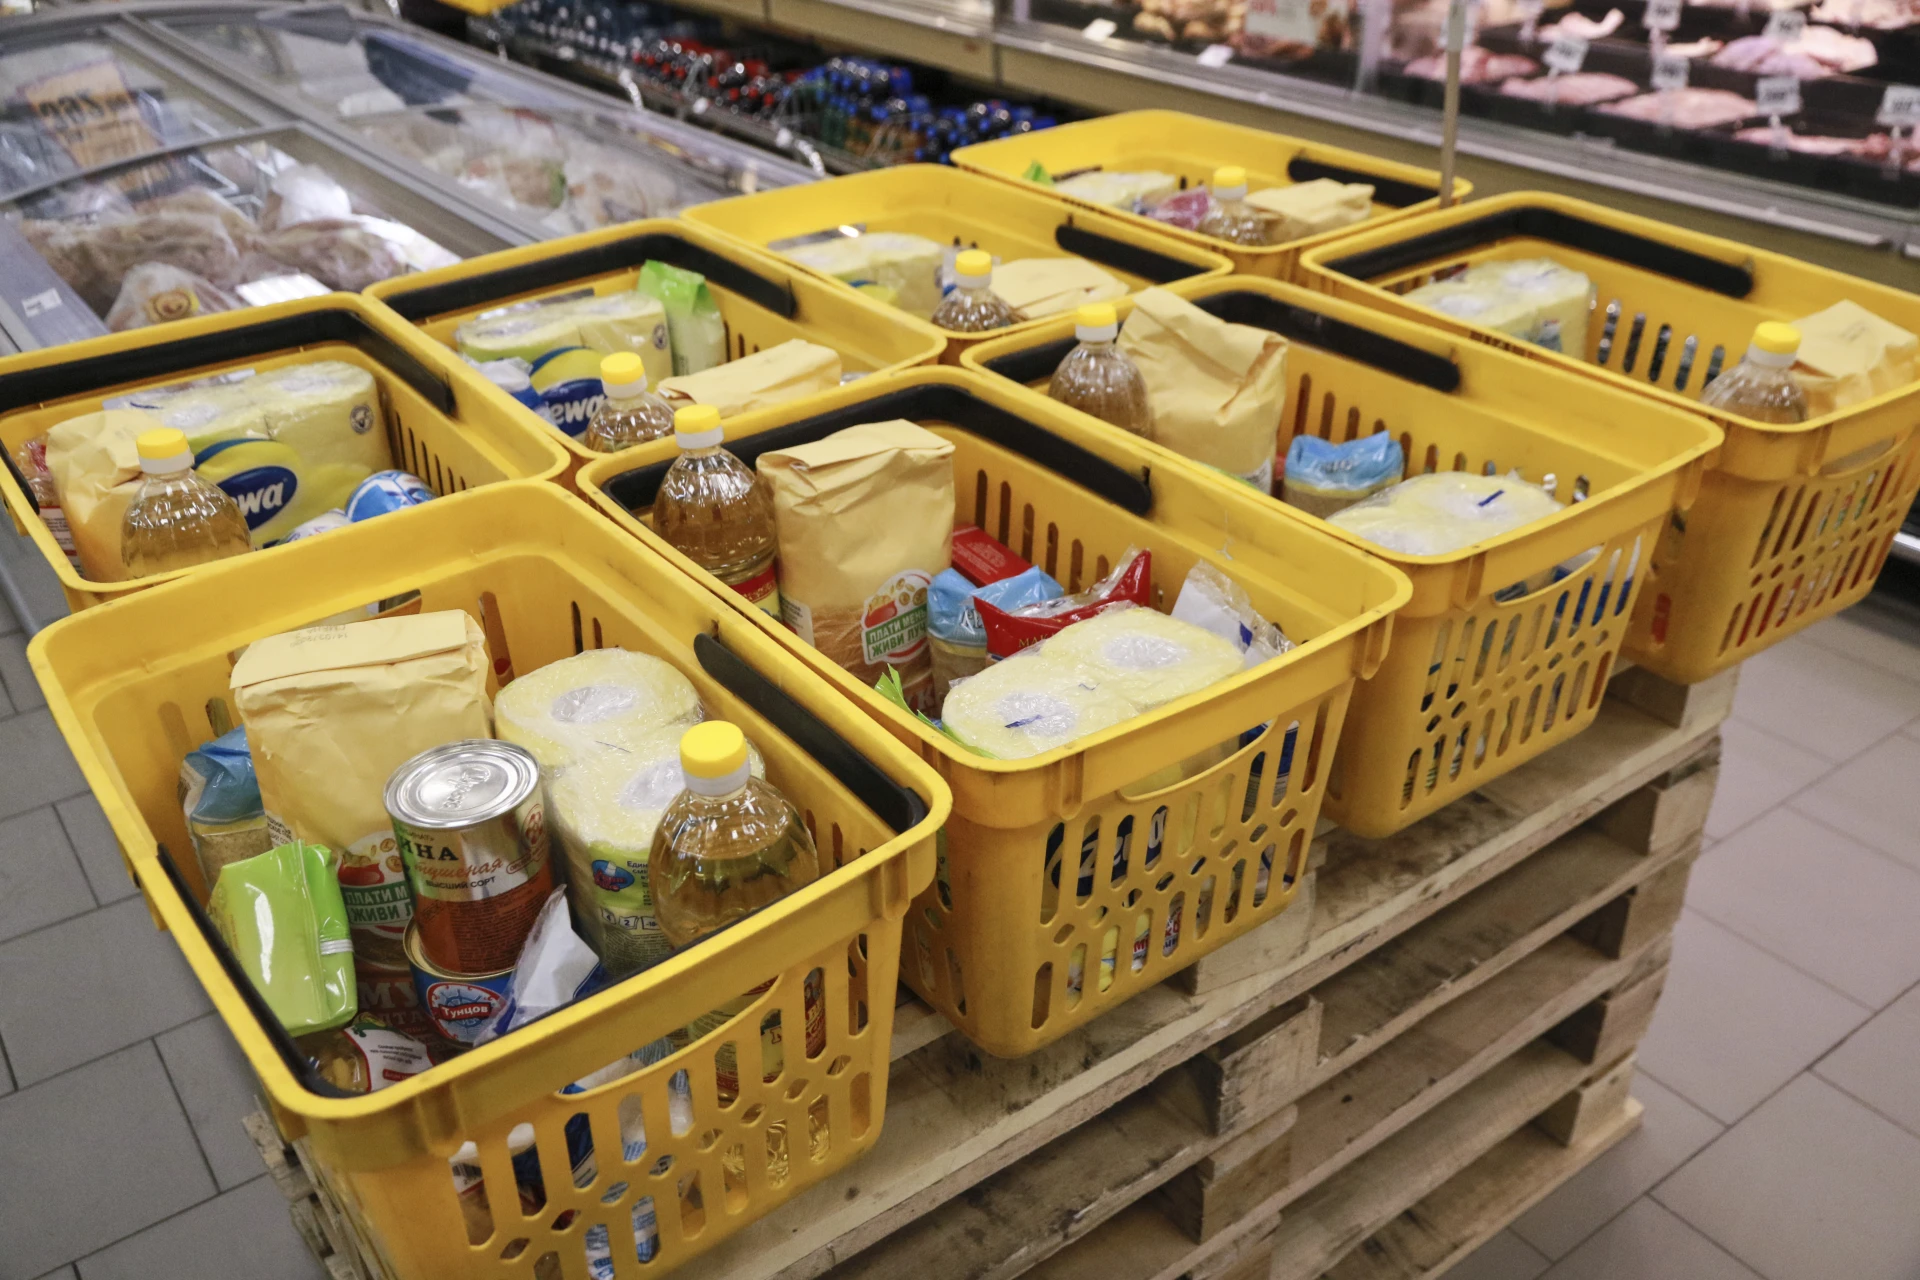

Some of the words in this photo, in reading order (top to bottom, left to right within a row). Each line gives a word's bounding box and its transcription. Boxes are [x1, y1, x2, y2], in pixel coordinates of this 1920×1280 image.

[231, 481, 284, 517] wa
[870, 620, 902, 644] ПЛАТИ
[902, 609, 926, 628] МЕНЬ
[871, 632, 905, 657] ЖИВИ
[907, 621, 926, 643] ЛУЧ
[470, 876, 496, 889] СОРТ
[345, 888, 393, 905] ПЛАТИ
[350, 905, 400, 923] ЖИВИ
[441, 1006, 488, 1019] Тунцов
